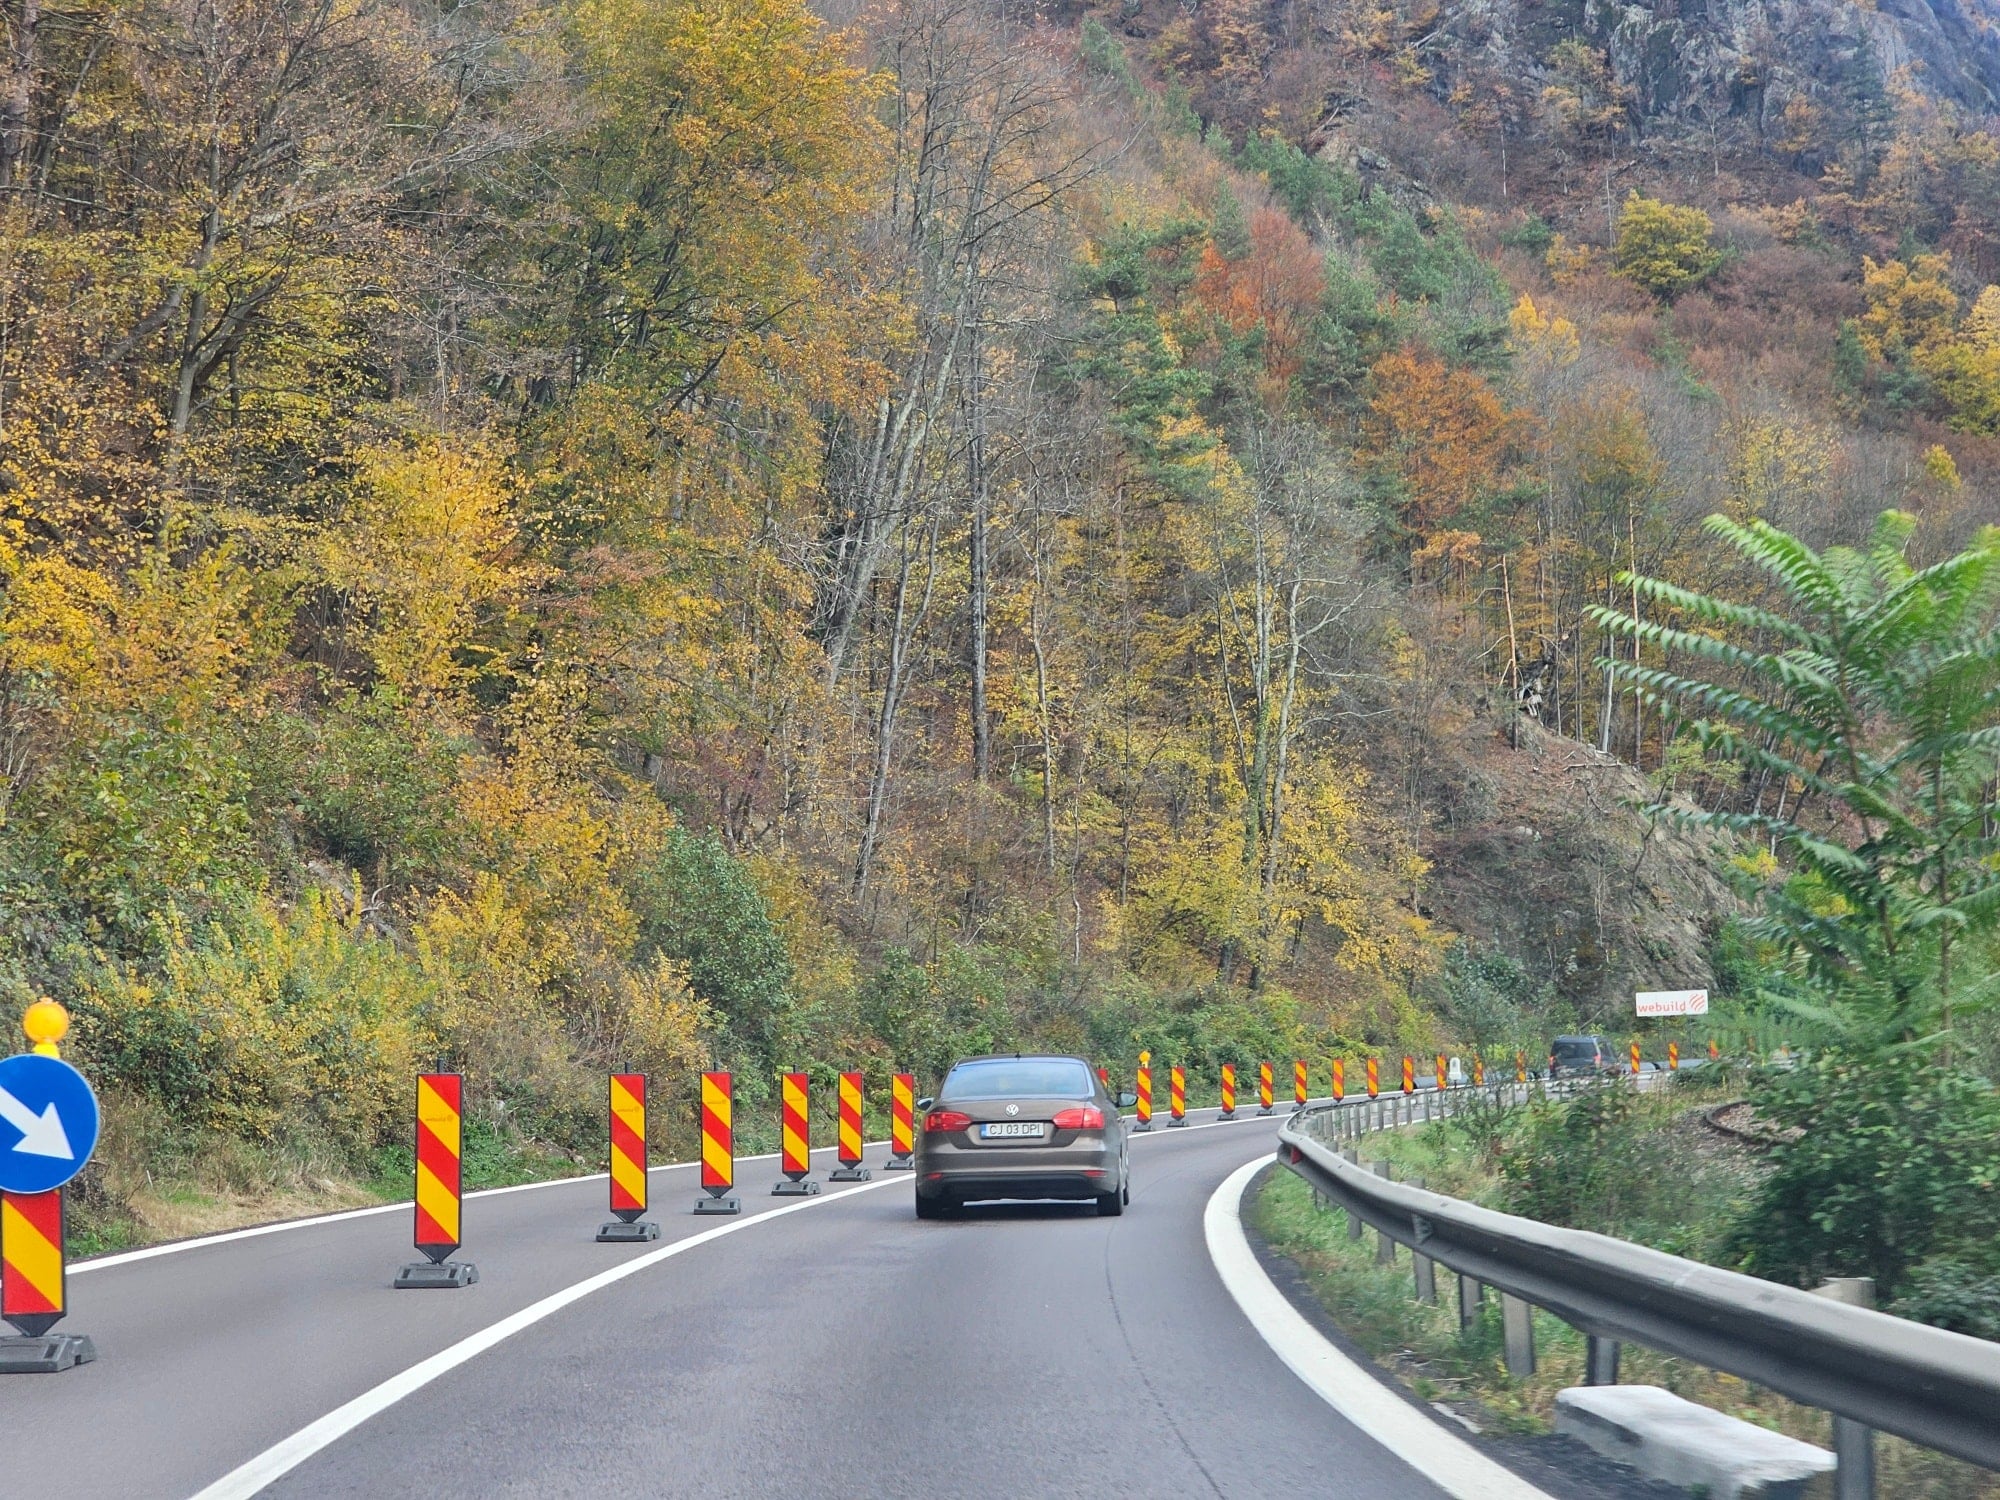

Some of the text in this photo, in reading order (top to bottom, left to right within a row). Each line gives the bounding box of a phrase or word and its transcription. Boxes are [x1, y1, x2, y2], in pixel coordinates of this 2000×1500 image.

[1638, 1000, 1686, 1012] webuild
[989, 1124, 1040, 1135] CJ 03 DPI
